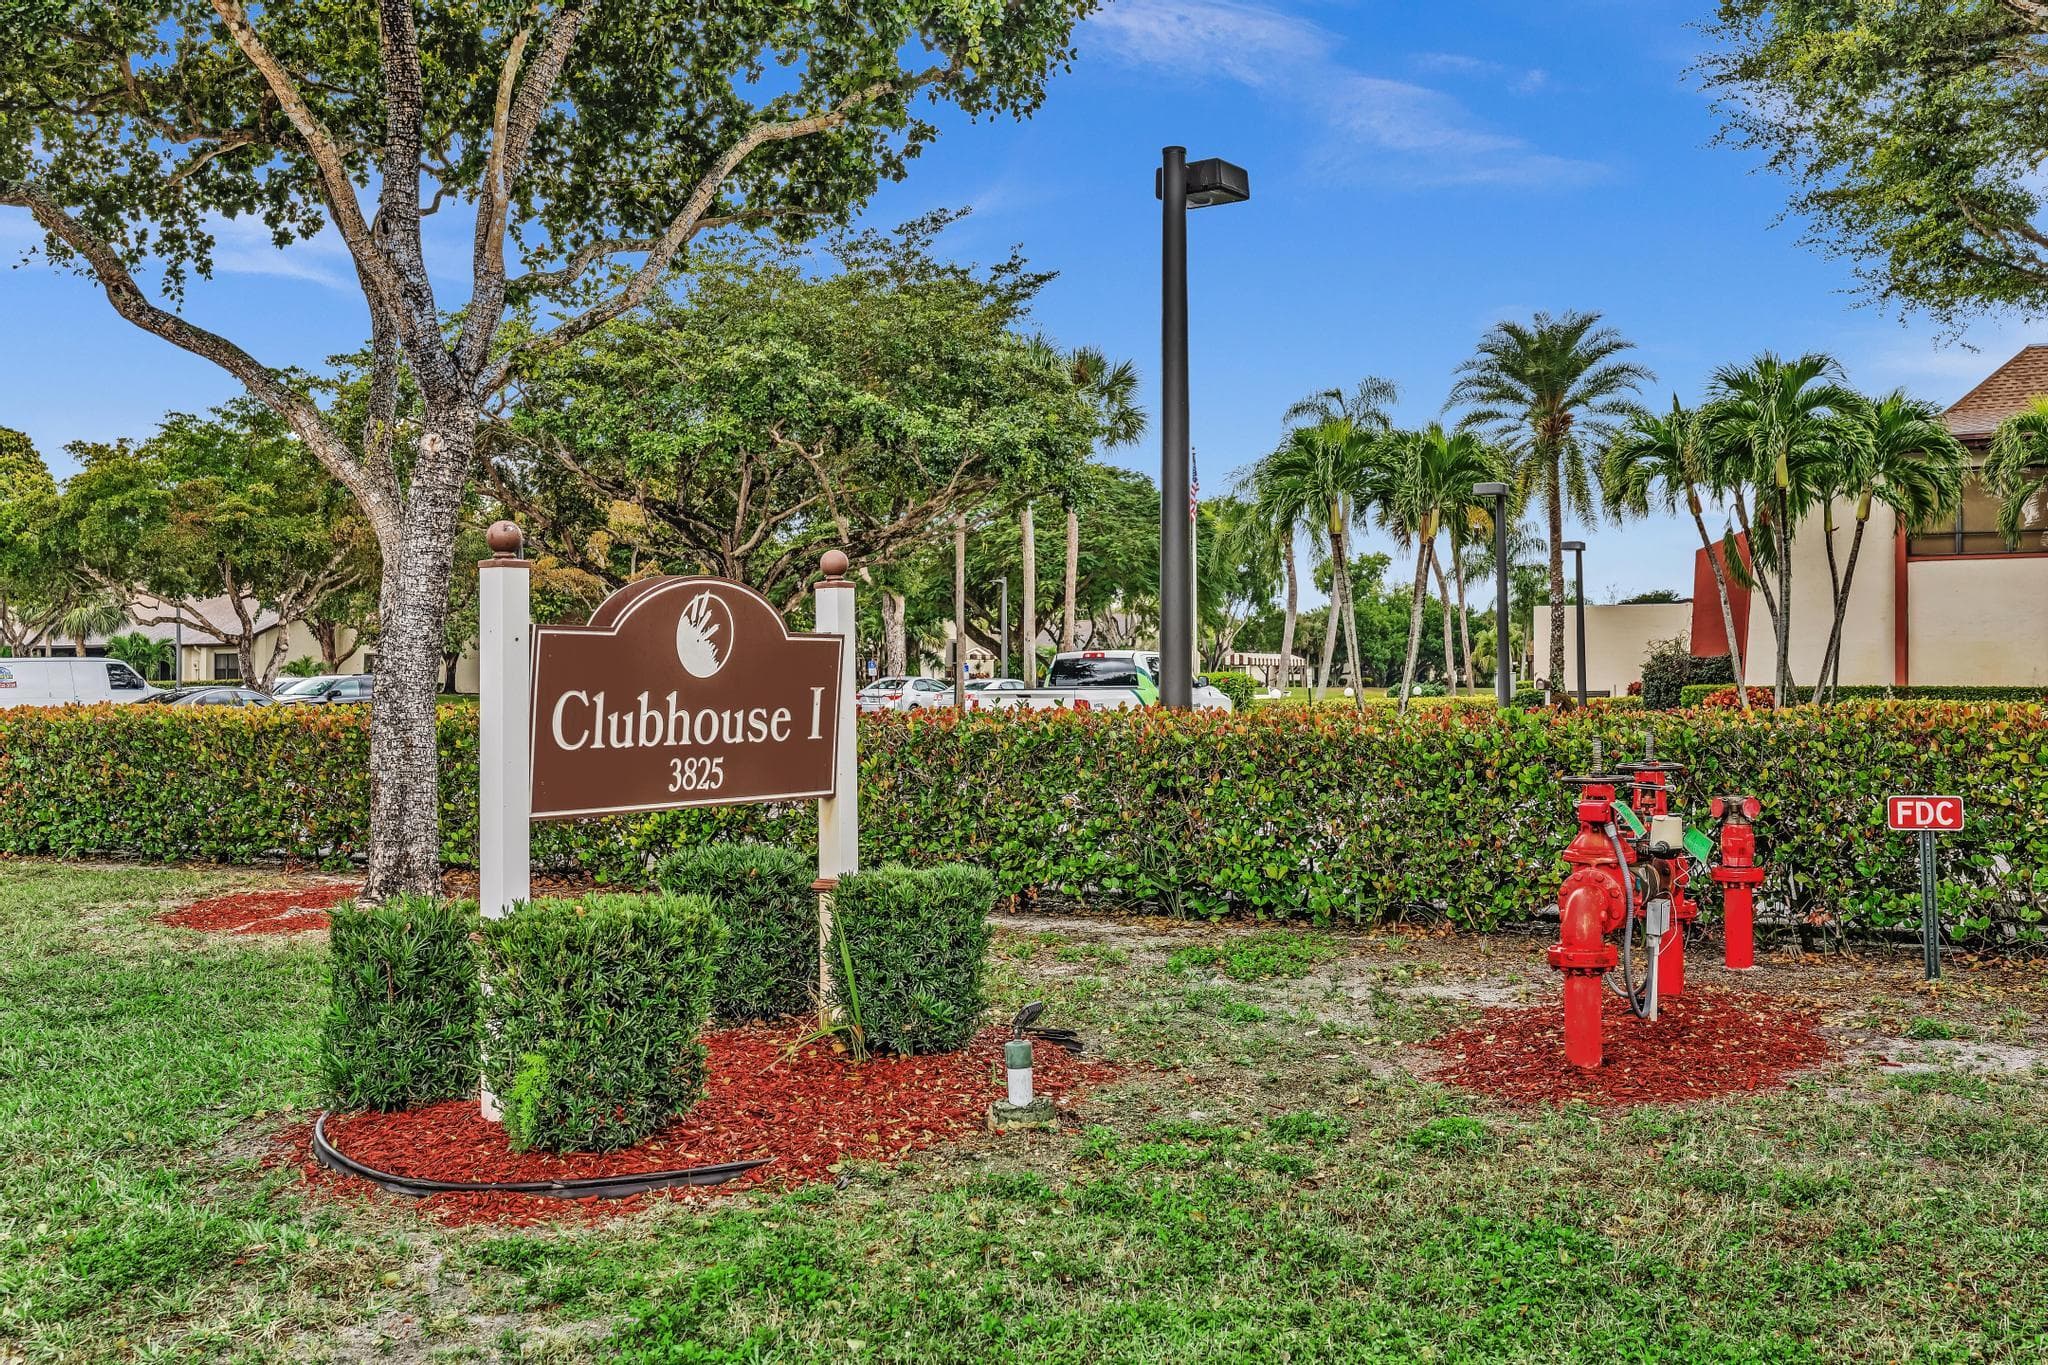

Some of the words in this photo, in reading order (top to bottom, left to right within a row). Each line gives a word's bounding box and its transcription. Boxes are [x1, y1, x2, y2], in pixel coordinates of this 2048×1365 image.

[551, 689, 792, 751] Clubhouse
[807, 686, 825, 740] I
[668, 756, 724, 792] 3825
[1896, 801, 1954, 826] FDC
